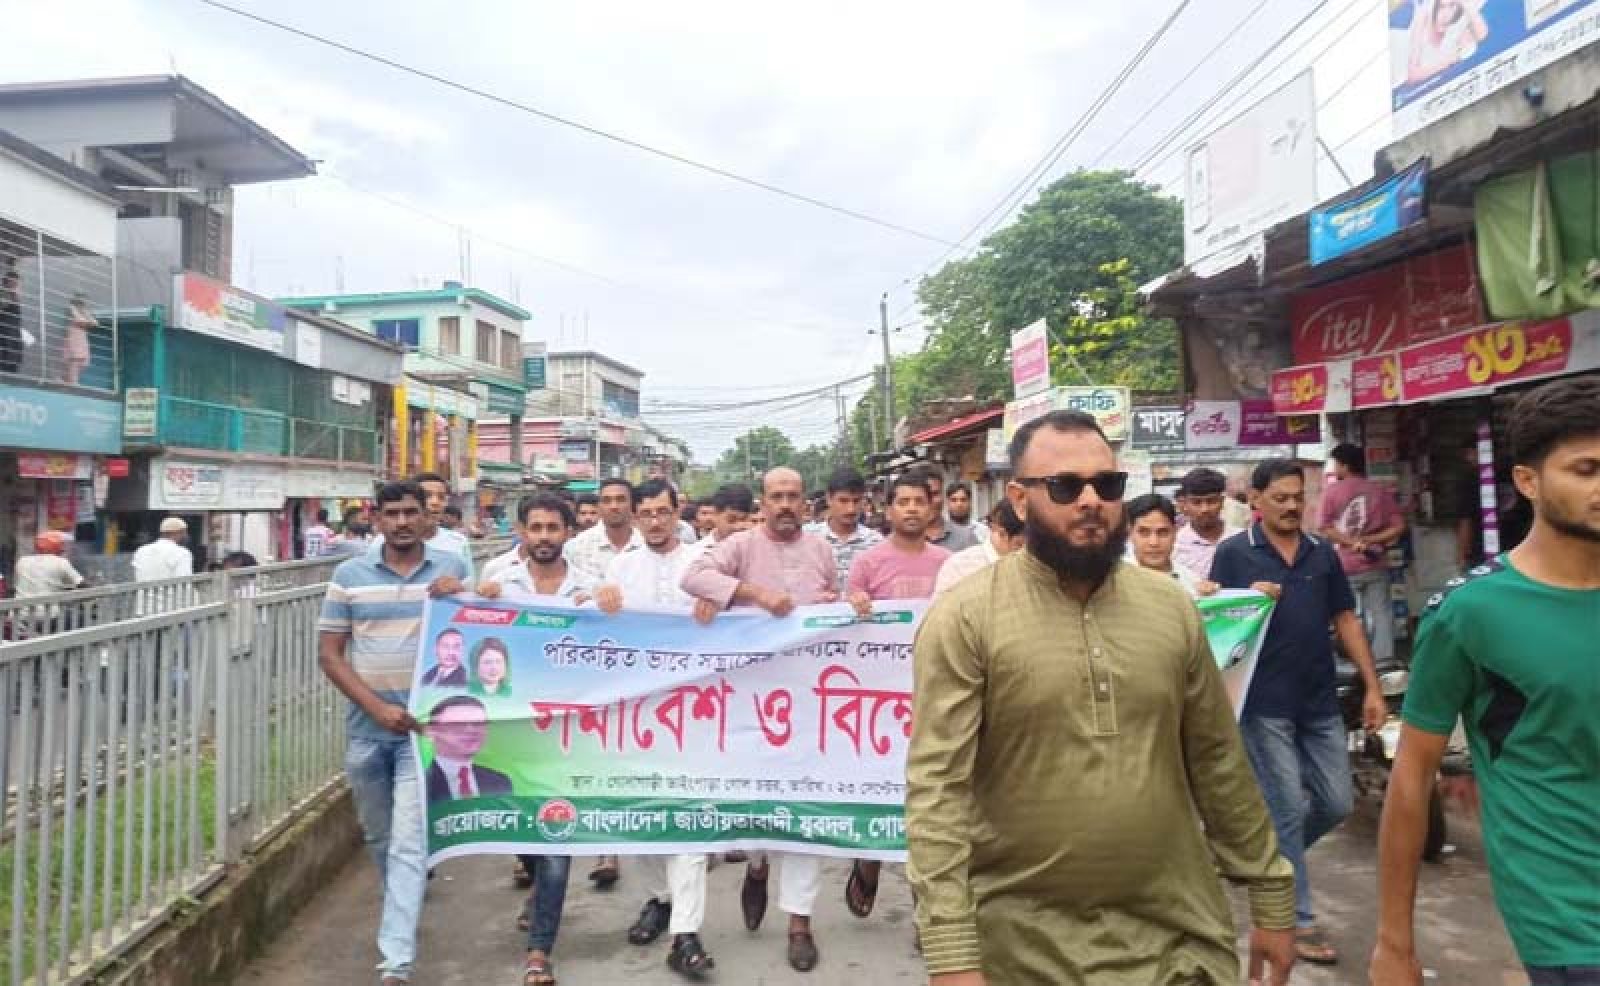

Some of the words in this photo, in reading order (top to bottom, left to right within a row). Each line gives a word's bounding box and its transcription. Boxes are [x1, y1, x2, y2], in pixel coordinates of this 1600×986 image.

[1321, 302, 1375, 350] itel
[529, 678, 736, 754] সমাবেশ
[753, 687, 792, 748] ও
[579, 808, 667, 833] বাংলাদেশ
